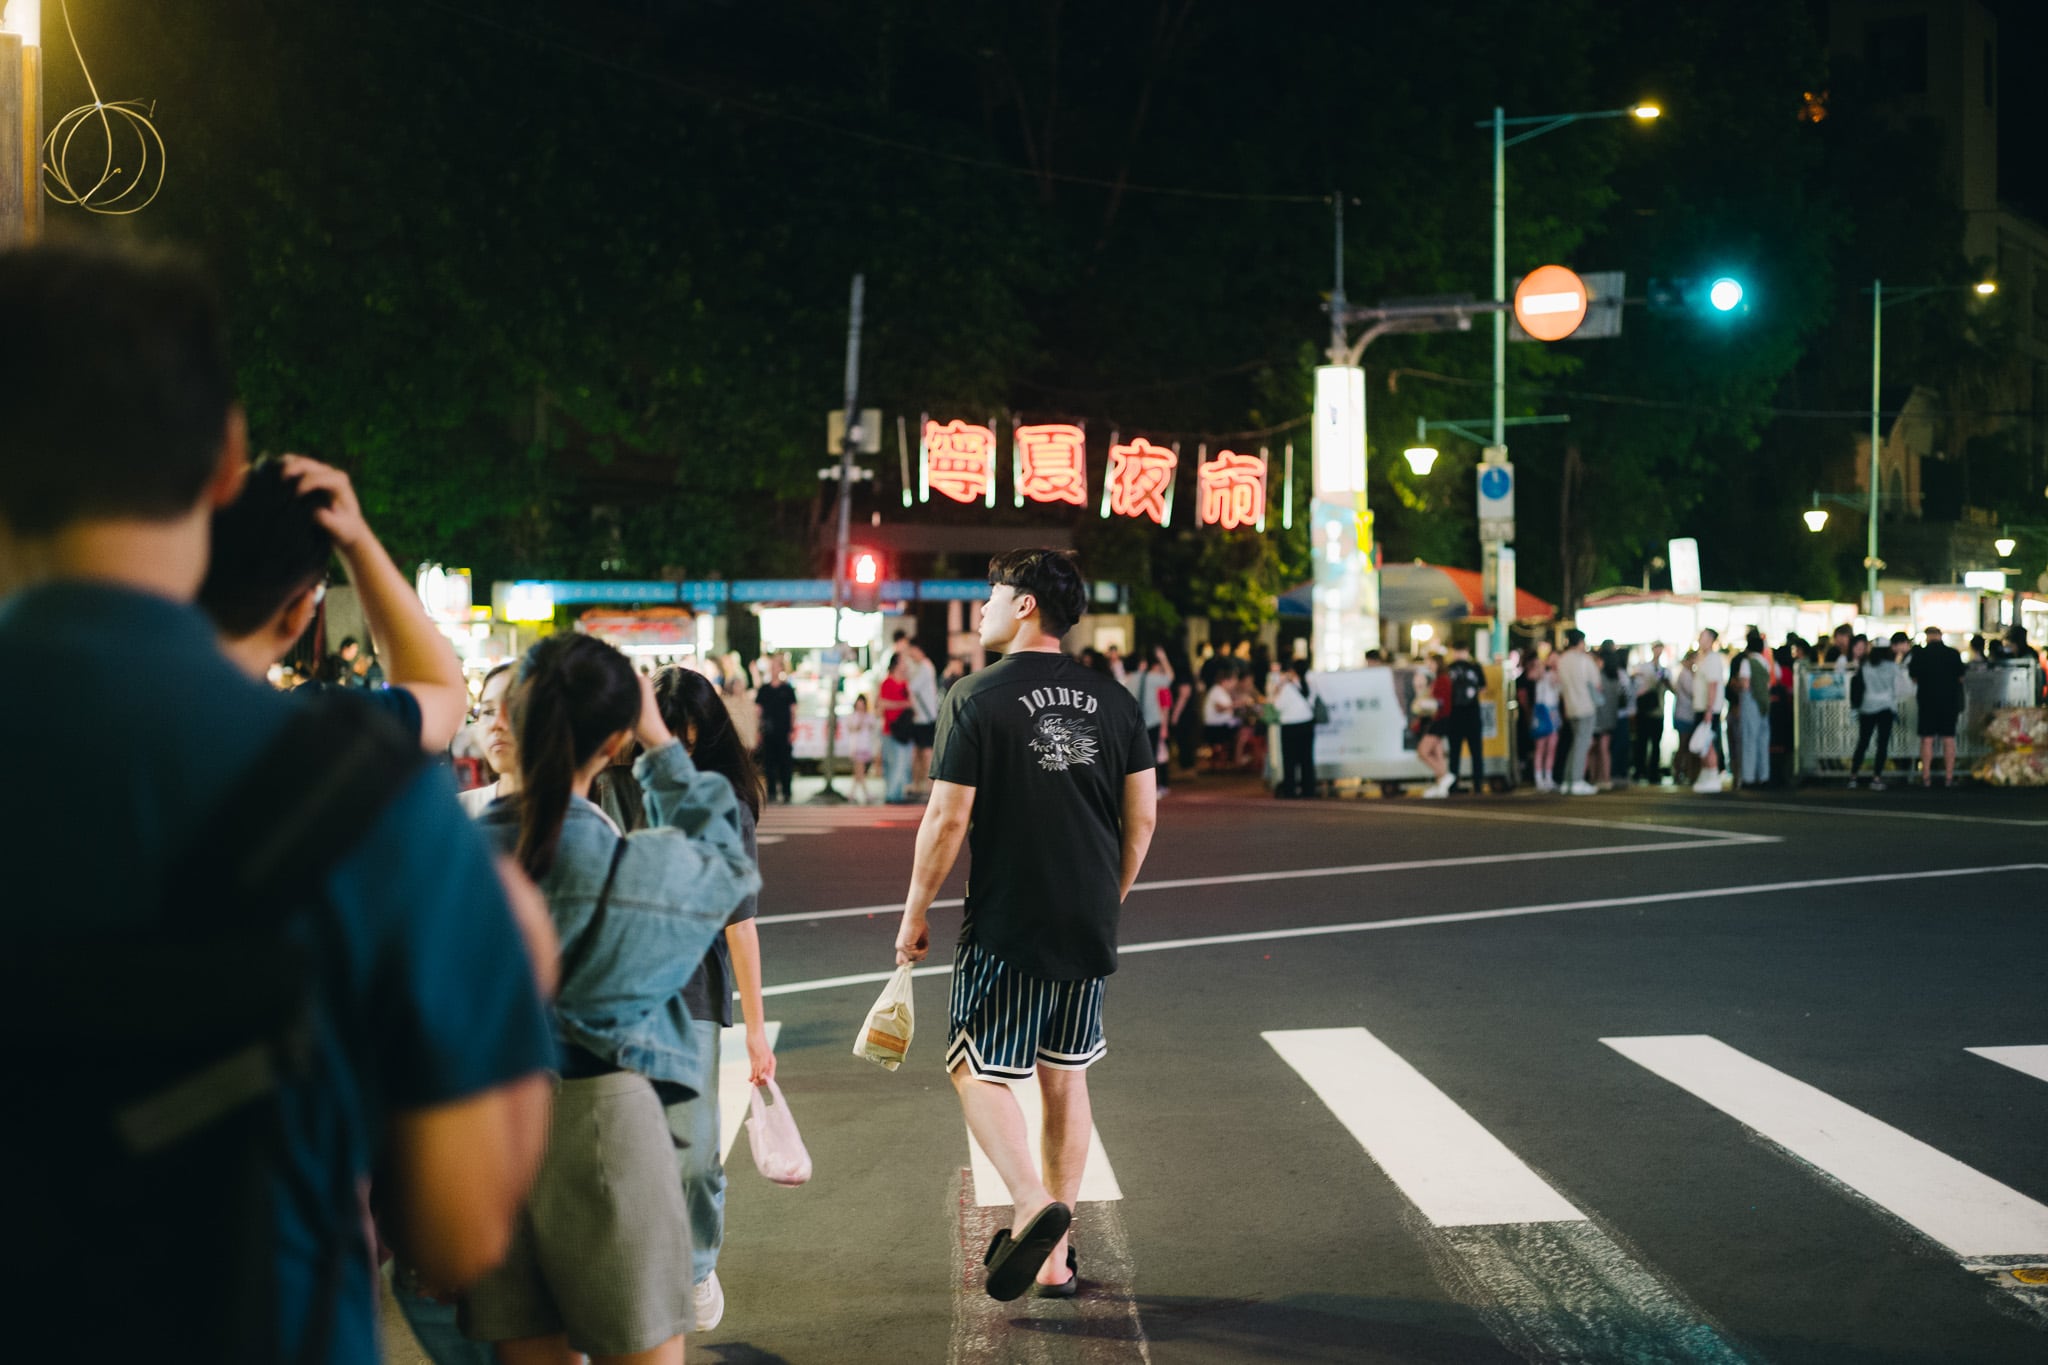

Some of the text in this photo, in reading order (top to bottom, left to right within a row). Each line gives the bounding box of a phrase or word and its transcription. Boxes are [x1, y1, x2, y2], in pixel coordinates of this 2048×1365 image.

[924, 419, 1267, 530] 寧夏夜市
[1018, 686, 1098, 717] JOINED
